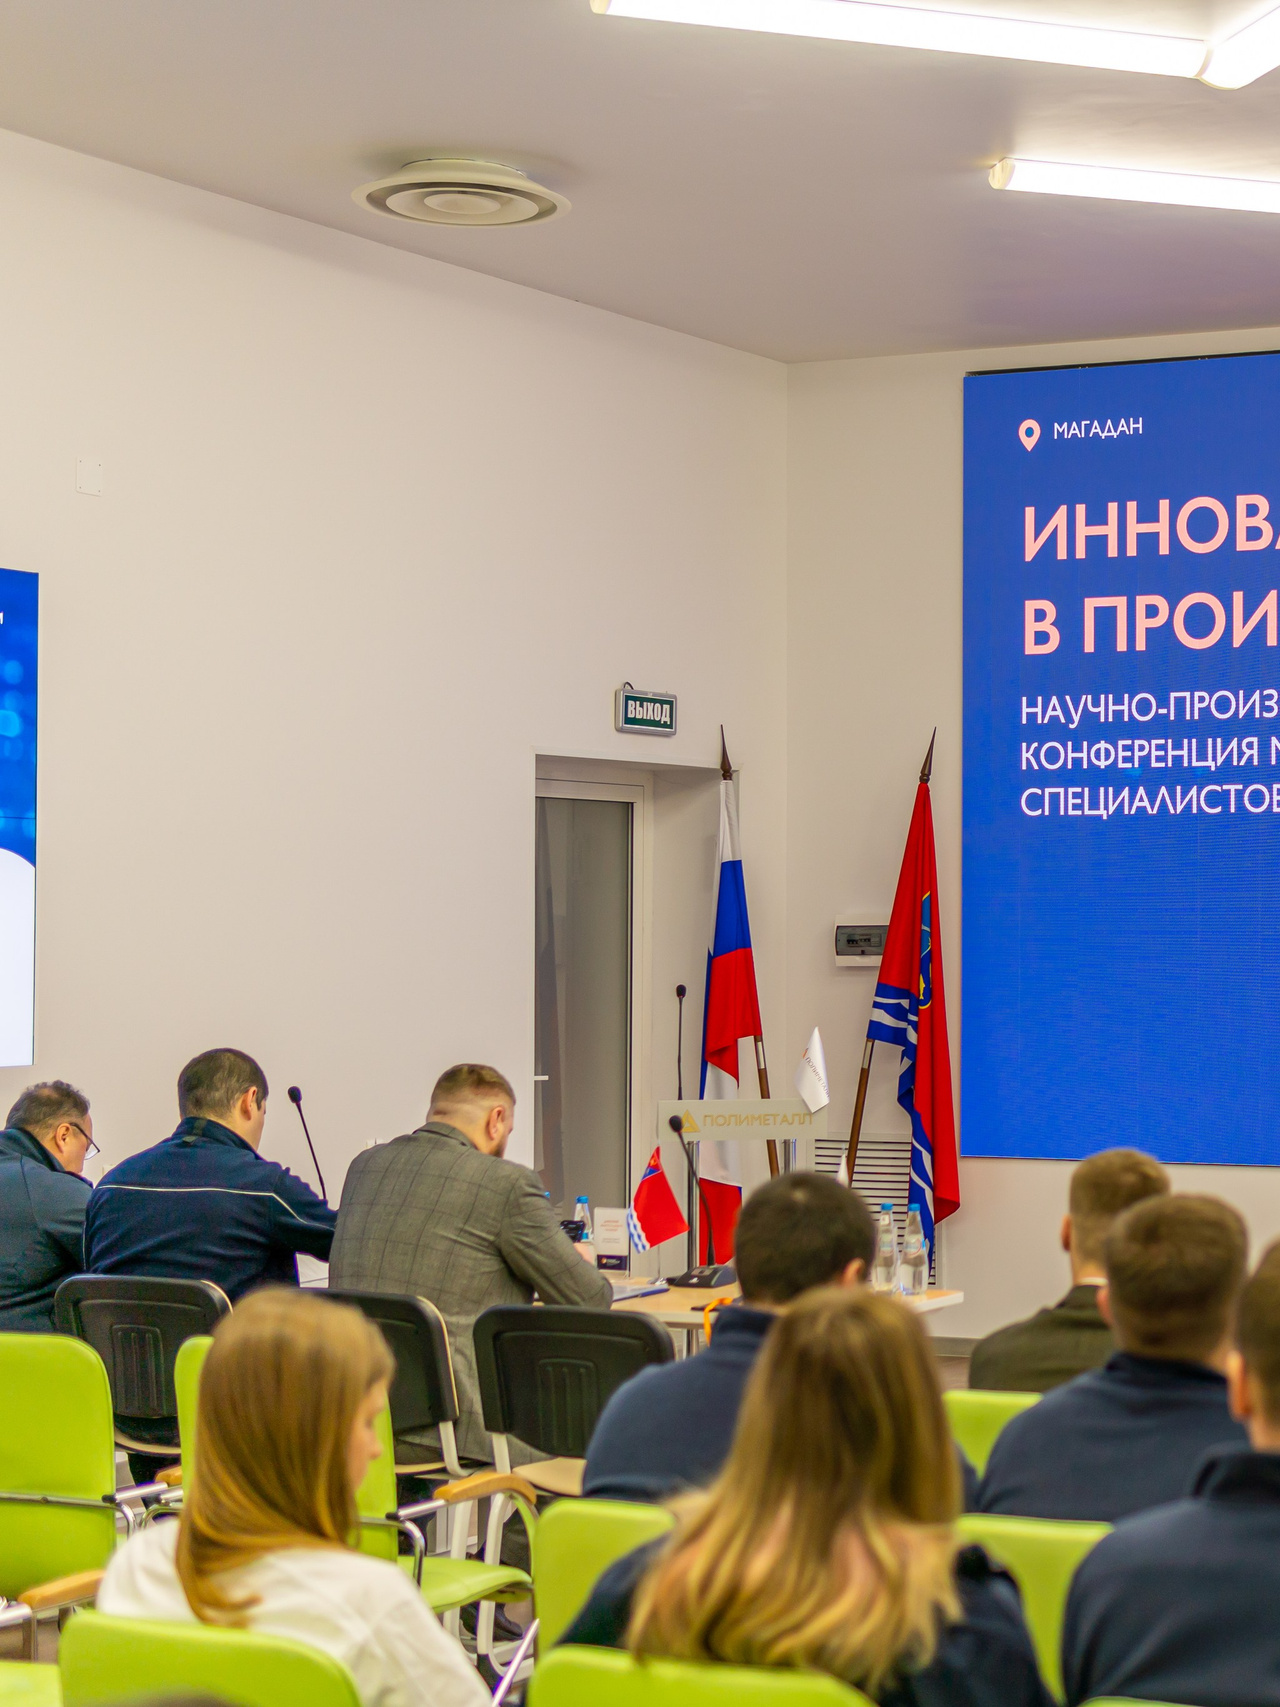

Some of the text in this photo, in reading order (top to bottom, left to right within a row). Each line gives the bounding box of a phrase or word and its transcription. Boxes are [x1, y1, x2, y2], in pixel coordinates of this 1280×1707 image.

[1053, 417, 1143, 439] МАГАДАН
[1024, 599, 1061, 655] В
[627, 700, 671, 724] ВЫХОД
[1021, 737, 1259, 772] КОНФЕРЕНЦИЯ
[703, 1113, 813, 1127] ПОЛИМЕТАЛЛ
